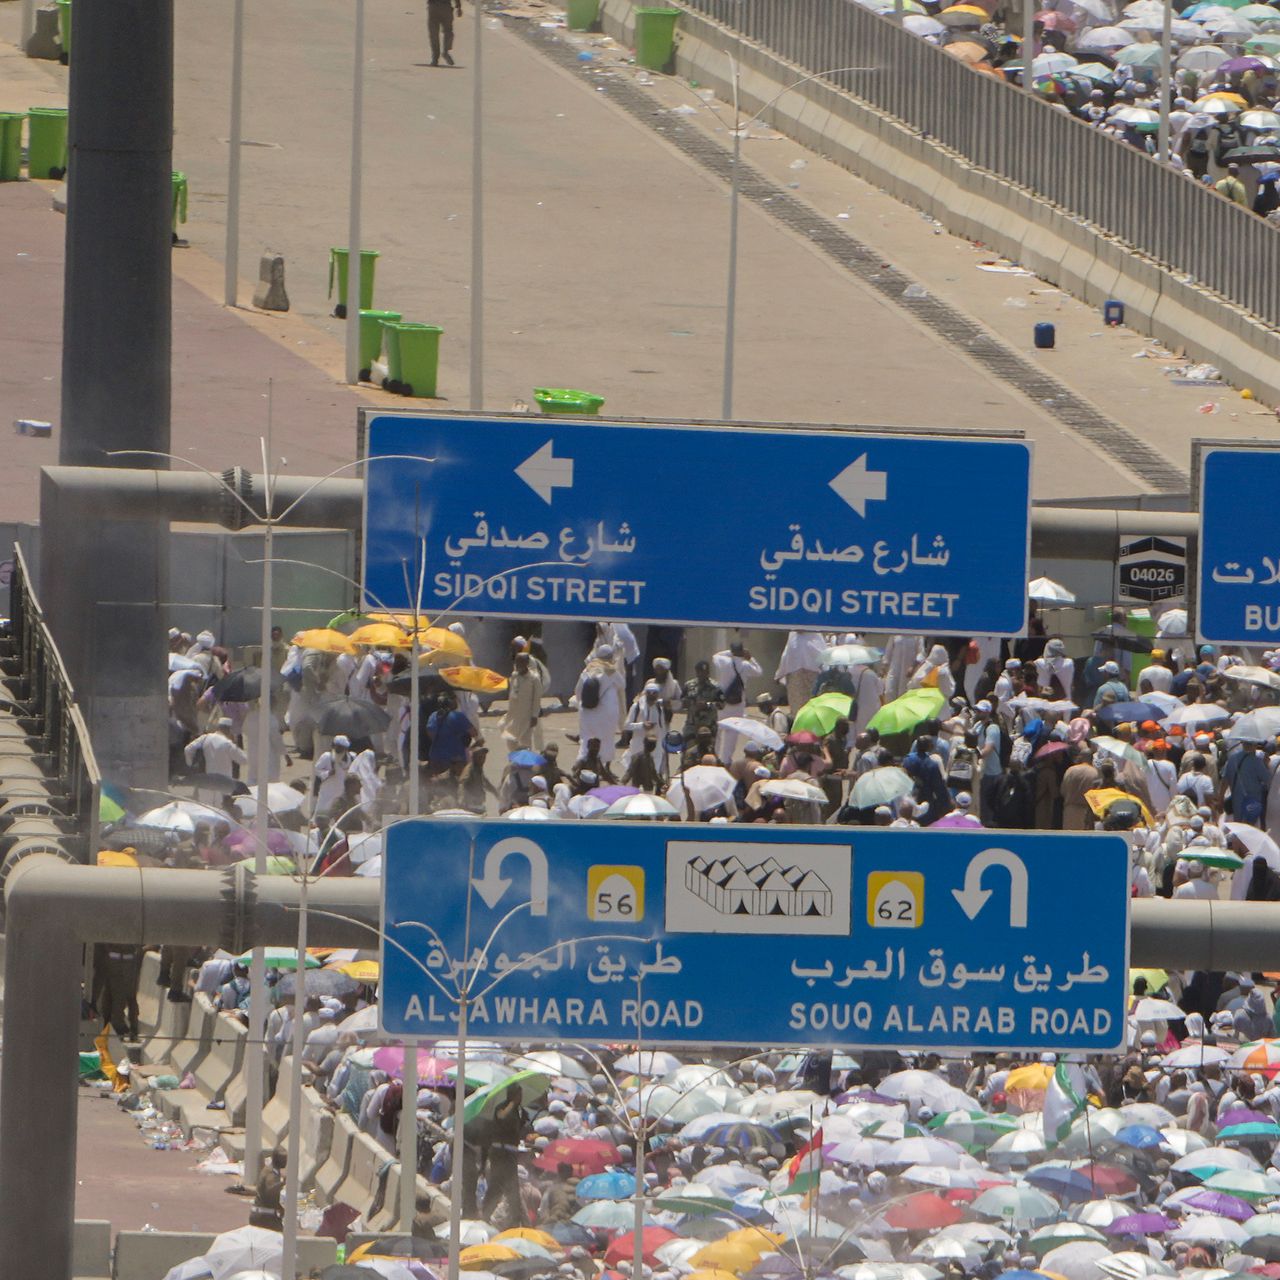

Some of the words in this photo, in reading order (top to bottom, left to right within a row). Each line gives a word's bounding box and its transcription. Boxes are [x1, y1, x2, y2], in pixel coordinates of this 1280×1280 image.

[444, 511, 546, 567] صدقي
[554, 522, 635, 567] شارع
[761, 525, 864, 580] صدقي
[873, 535, 949, 575] شارع
[433, 573, 518, 602] SIDQI
[527, 576, 645, 604] STREET
[1129, 566, 1177, 583] 04026
[750, 586, 831, 613] SIDQI
[842, 590, 959, 617] STREET
[598, 893, 633, 915] 56
[877, 900, 913, 921] 62
[425, 938, 578, 982] الجوهرة
[587, 943, 682, 983] طريق
[791, 948, 905, 987] العرب
[919, 949, 1005, 989] سوق
[1014, 952, 1109, 993] طريق
[621, 999, 703, 1031] ROAD
[789, 1002, 872, 1030] SOUQ
[883, 1005, 1015, 1033] ALARAB
[1031, 1007, 1111, 1034] ROAD
